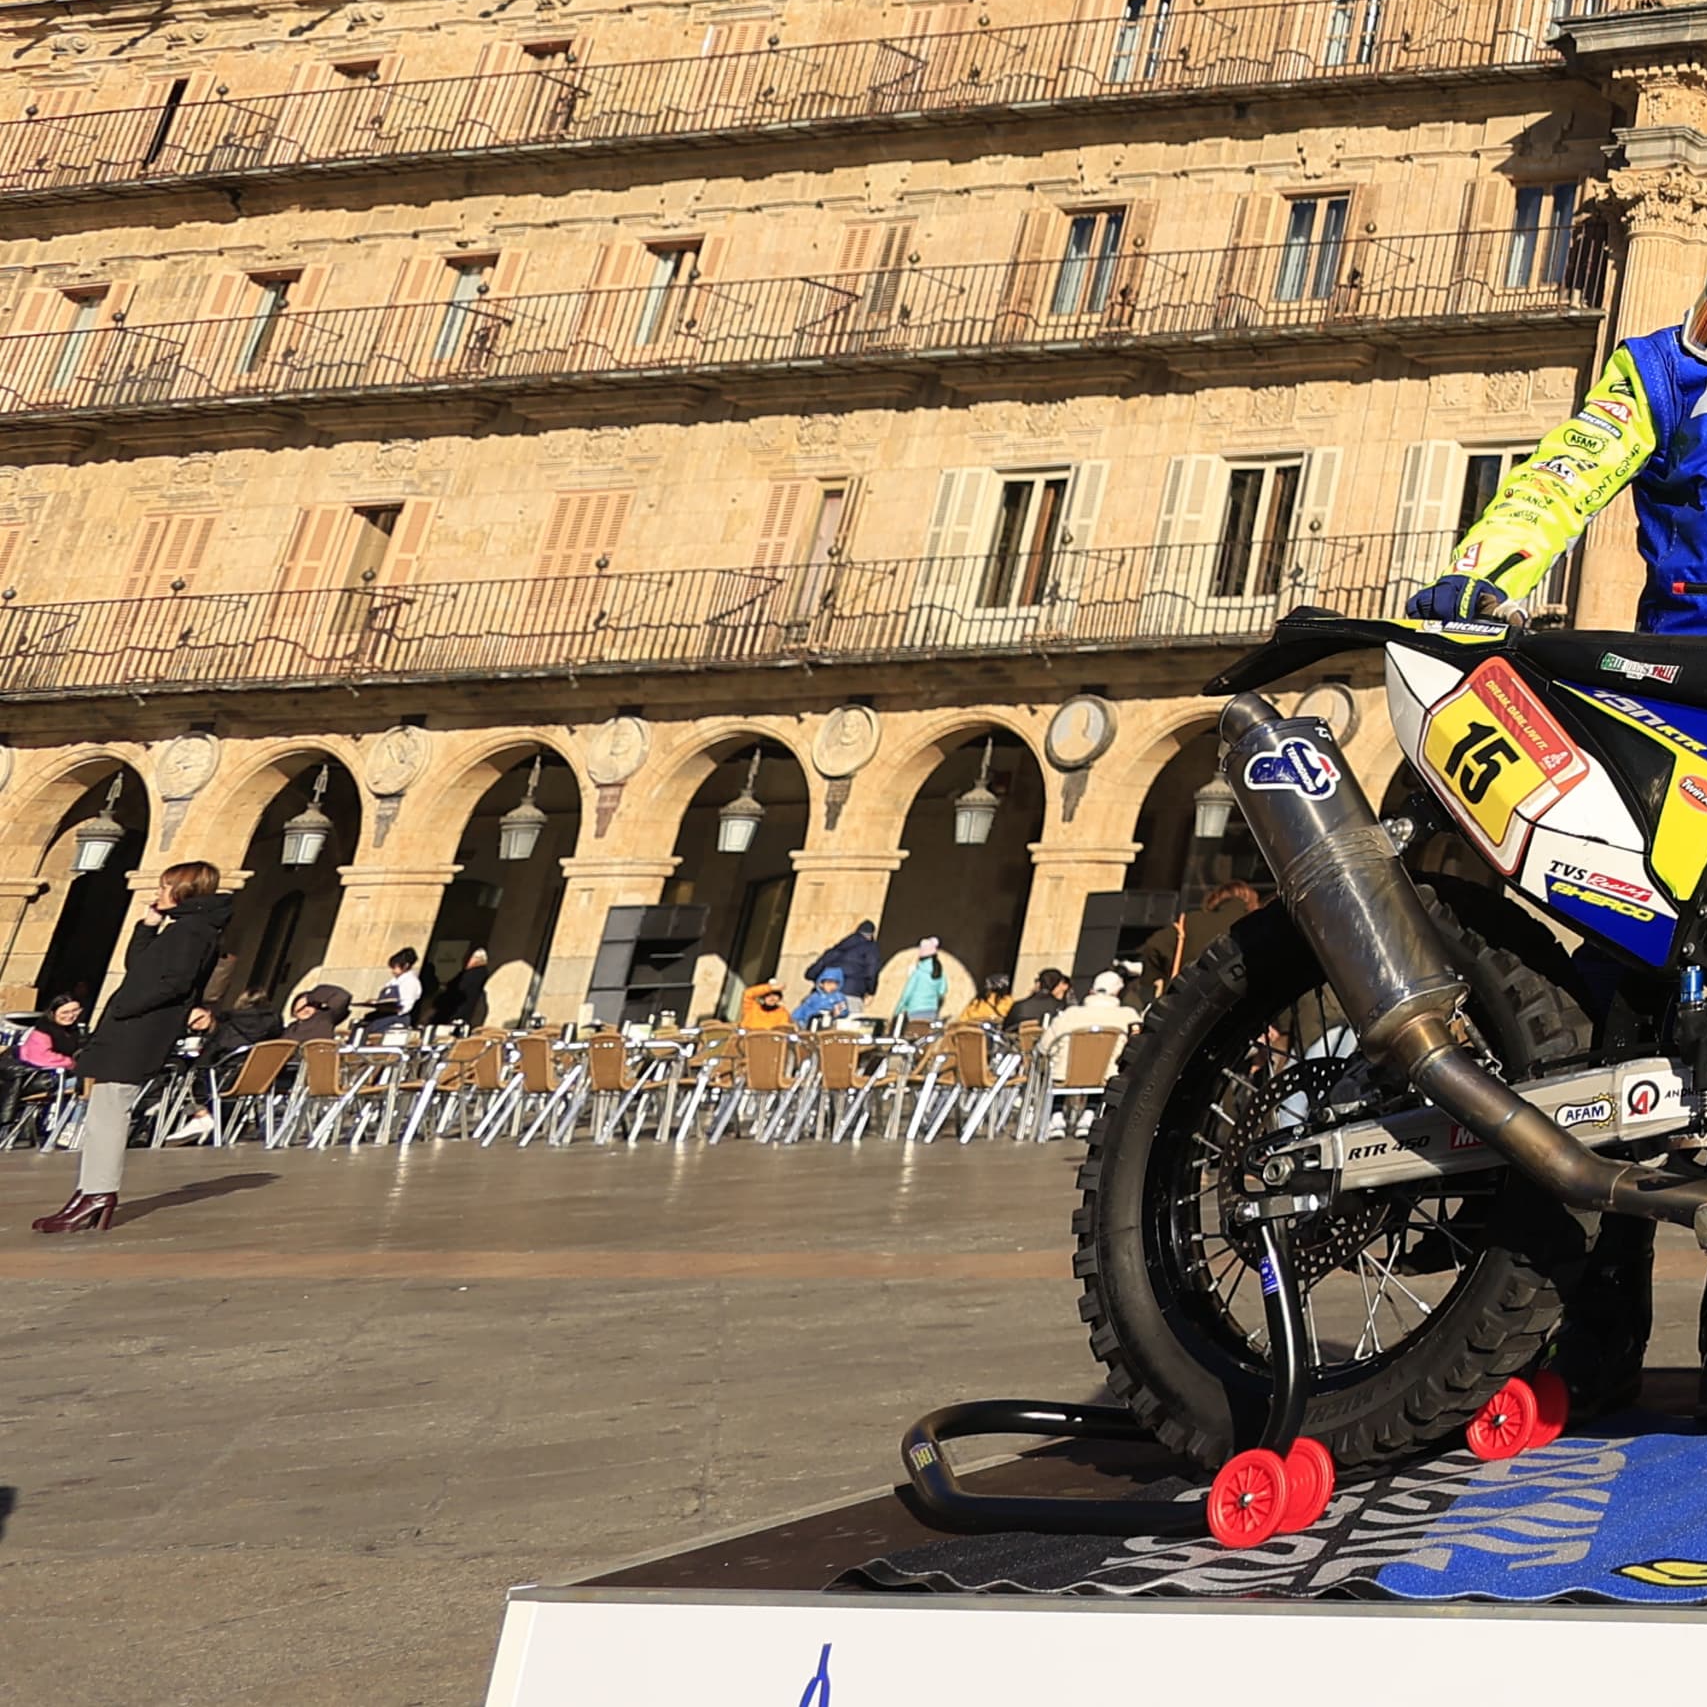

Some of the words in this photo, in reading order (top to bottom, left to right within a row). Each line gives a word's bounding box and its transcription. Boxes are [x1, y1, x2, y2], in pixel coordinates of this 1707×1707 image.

[1571, 435, 1597, 448] AFAM
[1444, 621, 1504, 634] MICHELIN
[1444, 720, 1521, 805] 15
[1681, 778, 1704, 799] Twin
[1549, 860, 1588, 881] TVS
[1551, 881, 1656, 922] SHERCO
[1564, 1104, 1607, 1122] AFAM
[1348, 1142, 1388, 1161] RTR
[1392, 1135, 1431, 1152] 450
